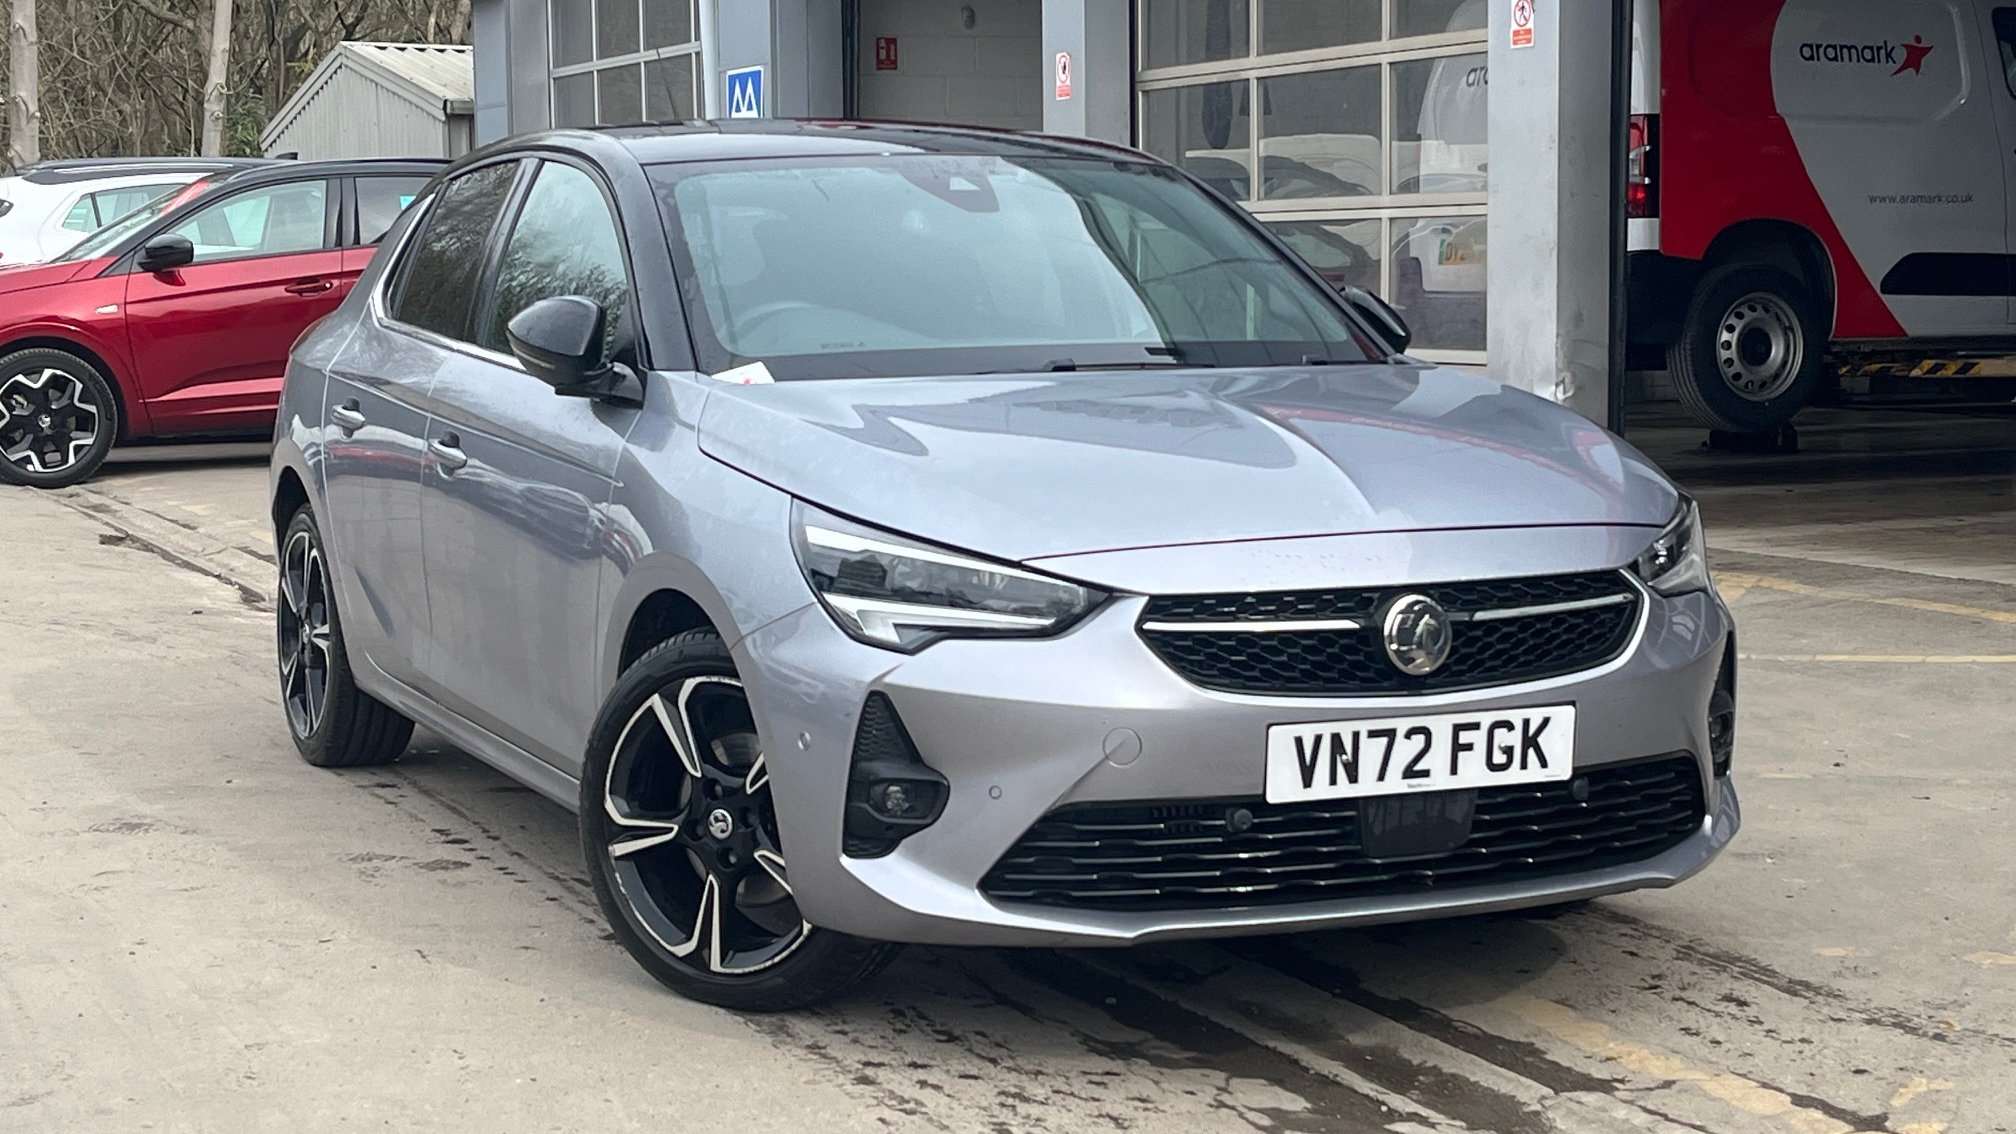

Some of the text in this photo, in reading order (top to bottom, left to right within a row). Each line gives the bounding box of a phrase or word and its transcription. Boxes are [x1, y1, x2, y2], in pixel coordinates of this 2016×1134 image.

[1799, 41, 1897, 64] aramark
[1867, 192, 1974, 205] www.aramark.co.uk
[1294, 717, 1552, 789] VN72 FGK
